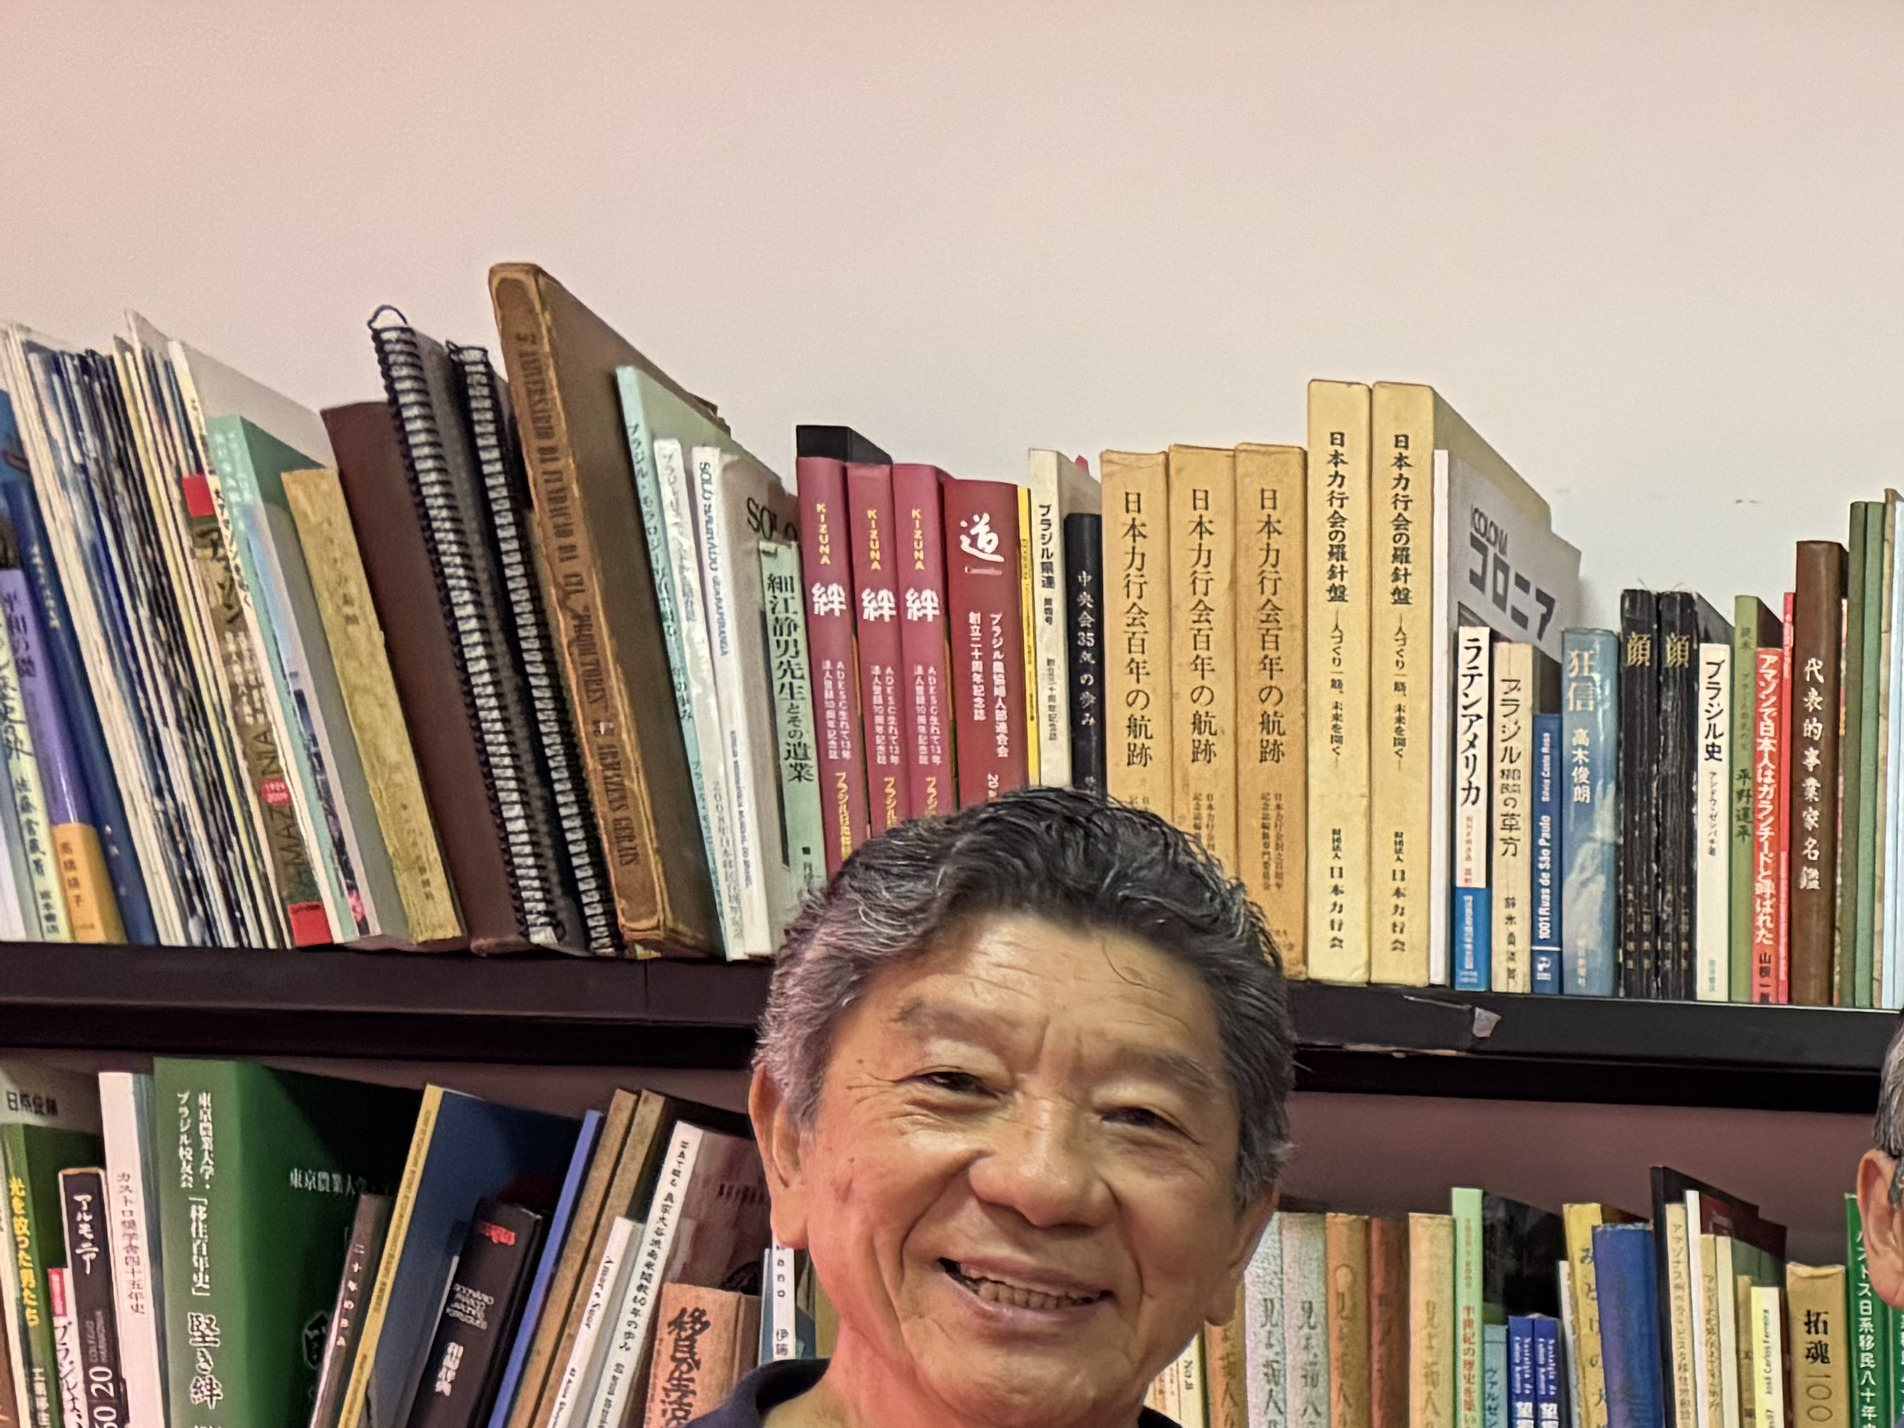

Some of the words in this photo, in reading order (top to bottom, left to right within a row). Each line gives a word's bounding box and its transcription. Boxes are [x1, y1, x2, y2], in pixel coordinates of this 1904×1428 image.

[815, 502, 832, 566] KIZUNA
[867, 508, 883, 572] KIZUNA
[911, 508, 926, 572] KIZUNA
[1326, 431, 1349, 603] 日本力行会の羅針盤
[1390, 434, 1414, 605] 日本力行会の羅針盤
[811, 582, 847, 617] 絆
[861, 587, 897, 623] 絆
[905, 588, 940, 623] 絆
[1469, 531, 1556, 642] コロニア
[1120, 491, 1154, 768] 日本力行会百年の航跡
[1188, 488, 1218, 765] 日本力行会百年の航跡
[1256, 487, 1286, 764] 日本力行会百年の航跡
[1626, 632, 1652, 668] 顔
[1666, 632, 1690, 669] 顔
[1568, 650, 1595, 712] 狂信
[1703, 659, 1725, 762] ブラジル史
[1460, 637, 1485, 807] ラテンアメリカ
[1538, 816, 1551, 847] Paulo
[1538, 849, 1551, 871] São
[1538, 873, 1551, 887] de
[1538, 889, 1551, 915] Ruas
[1538, 915, 1551, 940] 1001
[73, 1193, 100, 1276] アルモニア
[89, 1366, 115, 1399] 20
